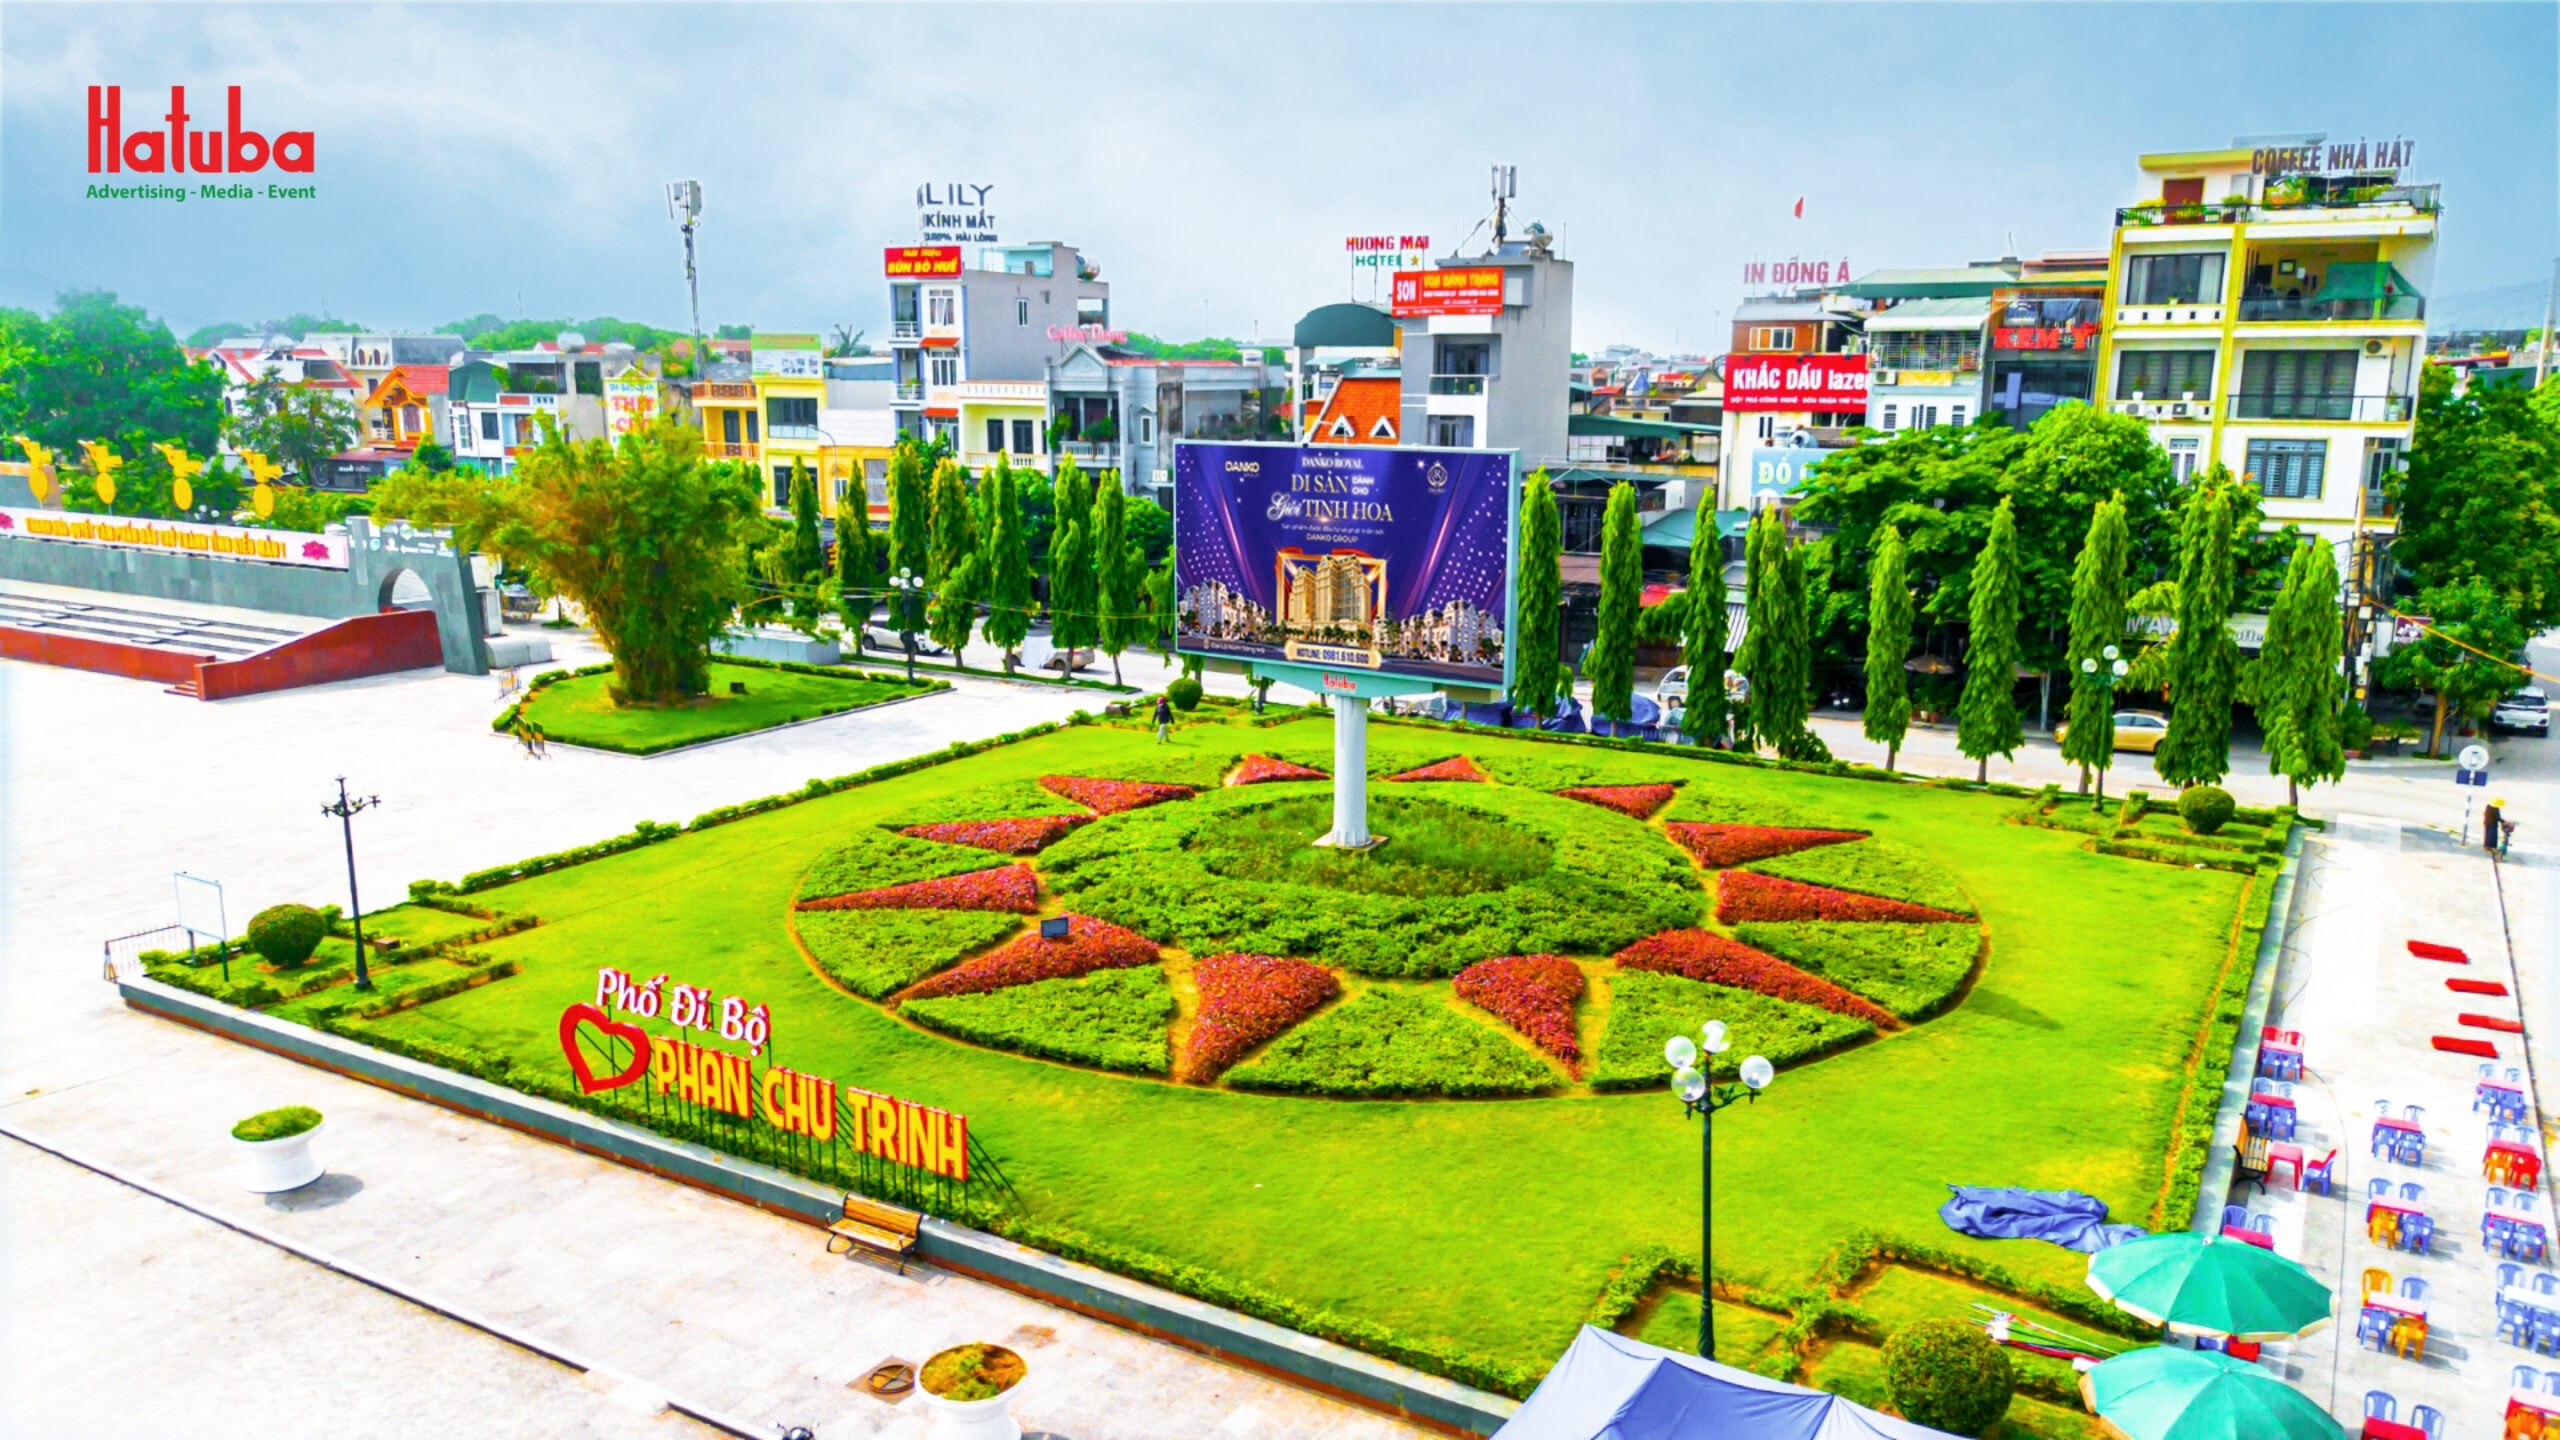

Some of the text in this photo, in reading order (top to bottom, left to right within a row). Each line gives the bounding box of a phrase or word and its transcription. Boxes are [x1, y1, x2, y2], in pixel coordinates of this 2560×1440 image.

[2252, 134, 2415, 175] COFFEE NHÀ HÁT
[925, 182, 994, 207] LILY
[925, 208, 996, 230] KÍNH MẮT
[1400, 235, 1430, 250] MAI
[887, 256, 959, 274] BÚN BÒ HUẾ
[1355, 254, 1403, 267] HOTEL
[1743, 262, 1766, 284] IN
[1836, 256, 1850, 283] Á
[1993, 327, 2060, 350] KEM
[1732, 360, 1781, 390] KHẮC
[1786, 362, 1823, 390] DẤU
[1225, 460, 1260, 472] DANKO
[1302, 456, 1333, 469] DANKO
[1291, 470, 1348, 493] DI SẢN
[1351, 486, 1369, 496] CHO
[1302, 499, 1349, 519] TINH
[1352, 501, 1394, 522] HOA
[1306, 532, 1359, 543] DANKO GROUP
[595, 967, 771, 1057] Phố Đi Bộ
[653, 1034, 968, 1182] PHAN CHU TRINH
